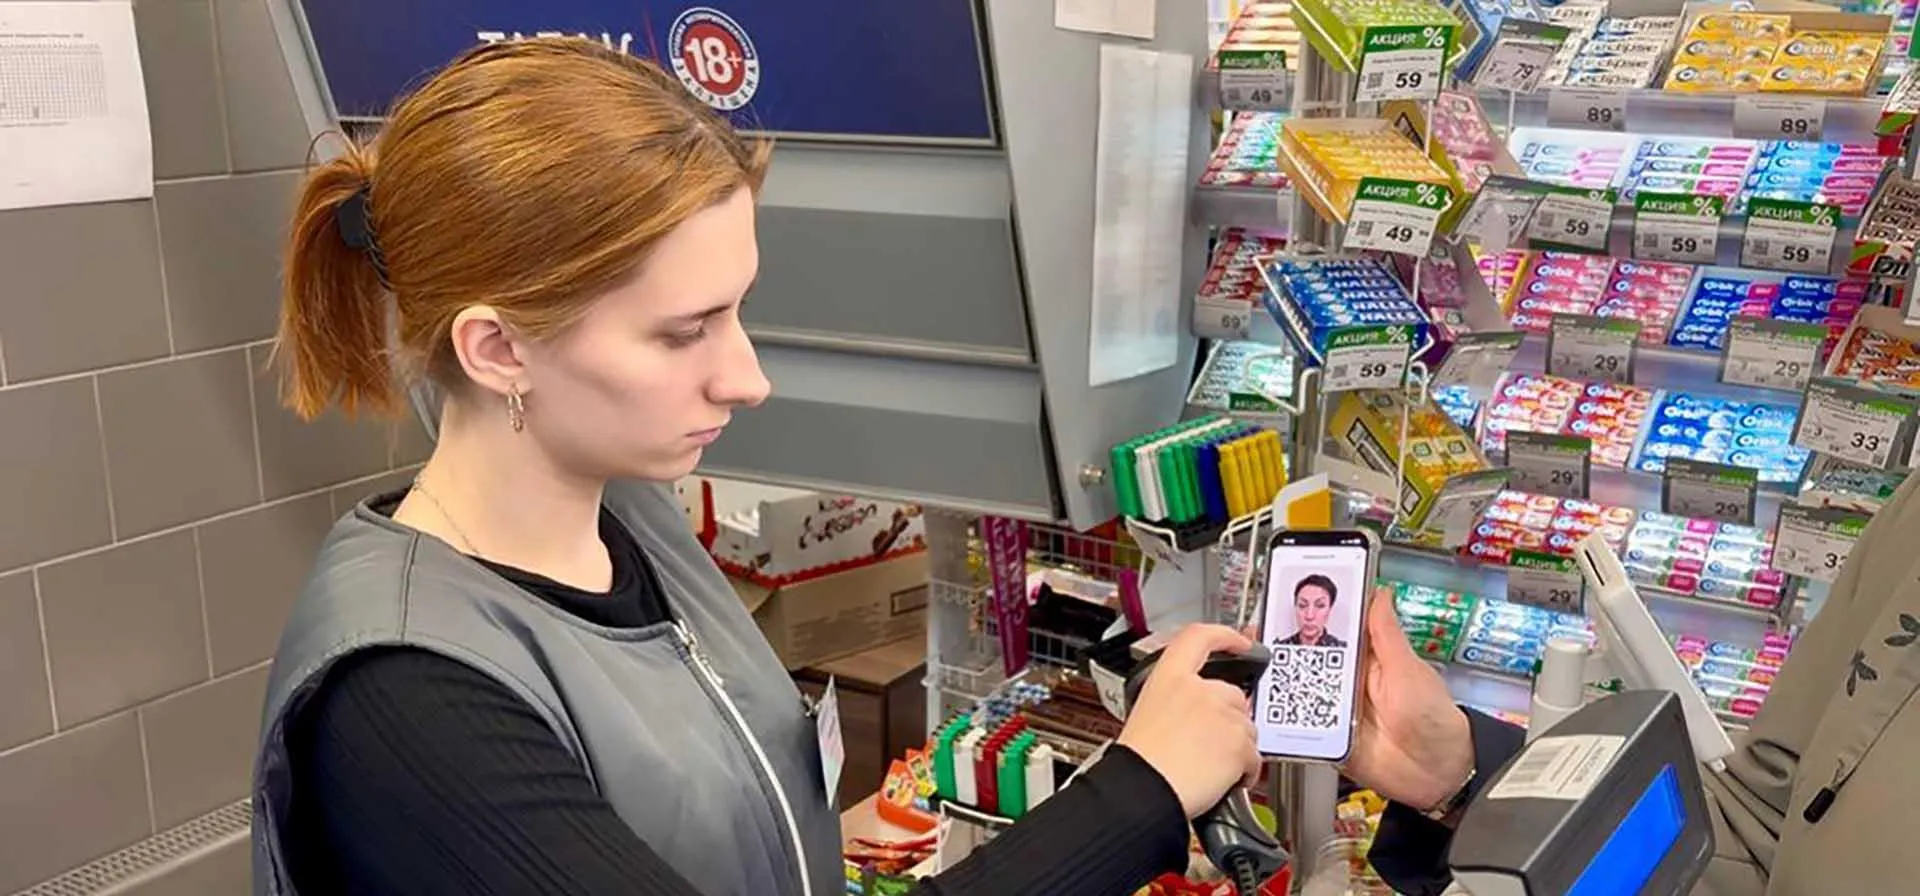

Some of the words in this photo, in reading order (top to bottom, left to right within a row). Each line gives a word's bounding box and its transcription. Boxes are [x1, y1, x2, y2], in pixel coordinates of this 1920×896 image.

[1369, 32, 1417, 46] АКЦИЯ
[684, 37, 742, 84] 18+
[1512, 62, 1534, 79] 79
[1395, 71, 1423, 89] 59
[1250, 89, 1272, 104] 49
[1587, 107, 1613, 123] 89
[1780, 118, 1808, 135] 89
[1362, 185, 1410, 198] АКЦИЯ
[1642, 200, 1688, 212] АКЦИЯ
[1753, 207, 1803, 220] АКЦИЯ
[1385, 225, 1413, 242] 49
[1564, 218, 1590, 237] 59
[1671, 237, 1698, 253] 59
[1782, 246, 1810, 263] 59
[1704, 280, 1735, 291] Orbit
[1788, 279, 1821, 290] Orbit
[1781, 297, 1814, 308] Orbit
[1358, 310, 1422, 322] HALLS
[1675, 332, 1709, 343] Orbit
[1359, 362, 1387, 378] 59
[1593, 353, 1619, 373] 29
[1773, 359, 1801, 378] 29
[1849, 431, 1881, 452] 33
[1550, 469, 1574, 486] 29
[1714, 501, 1739, 516] 29
[1549, 588, 1571, 603] 29
